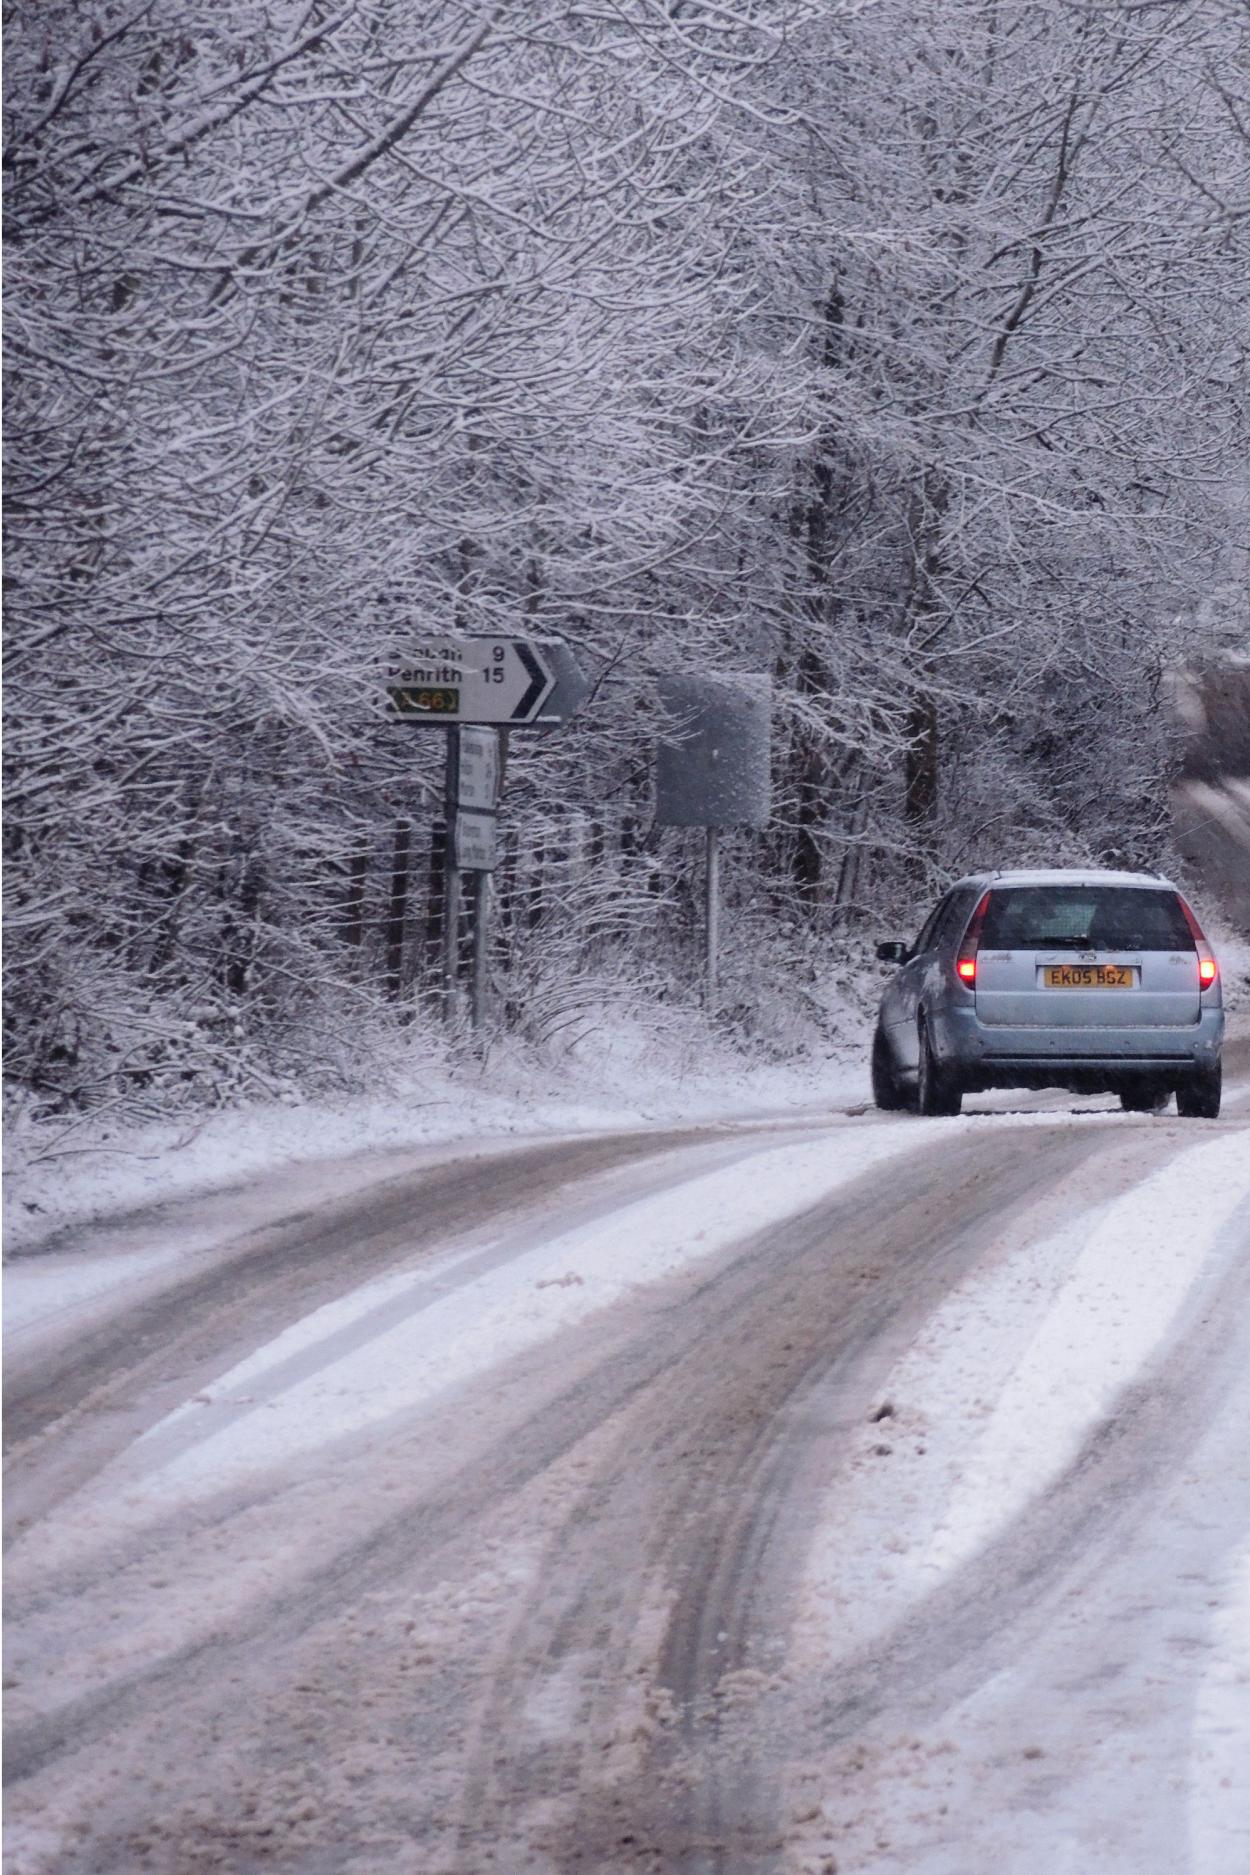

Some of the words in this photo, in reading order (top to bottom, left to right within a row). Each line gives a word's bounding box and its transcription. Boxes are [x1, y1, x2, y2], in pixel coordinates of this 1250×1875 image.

[492, 646, 505, 662] 9
[389, 666, 462, 683] Penrith
[482, 667, 505, 683] 15
